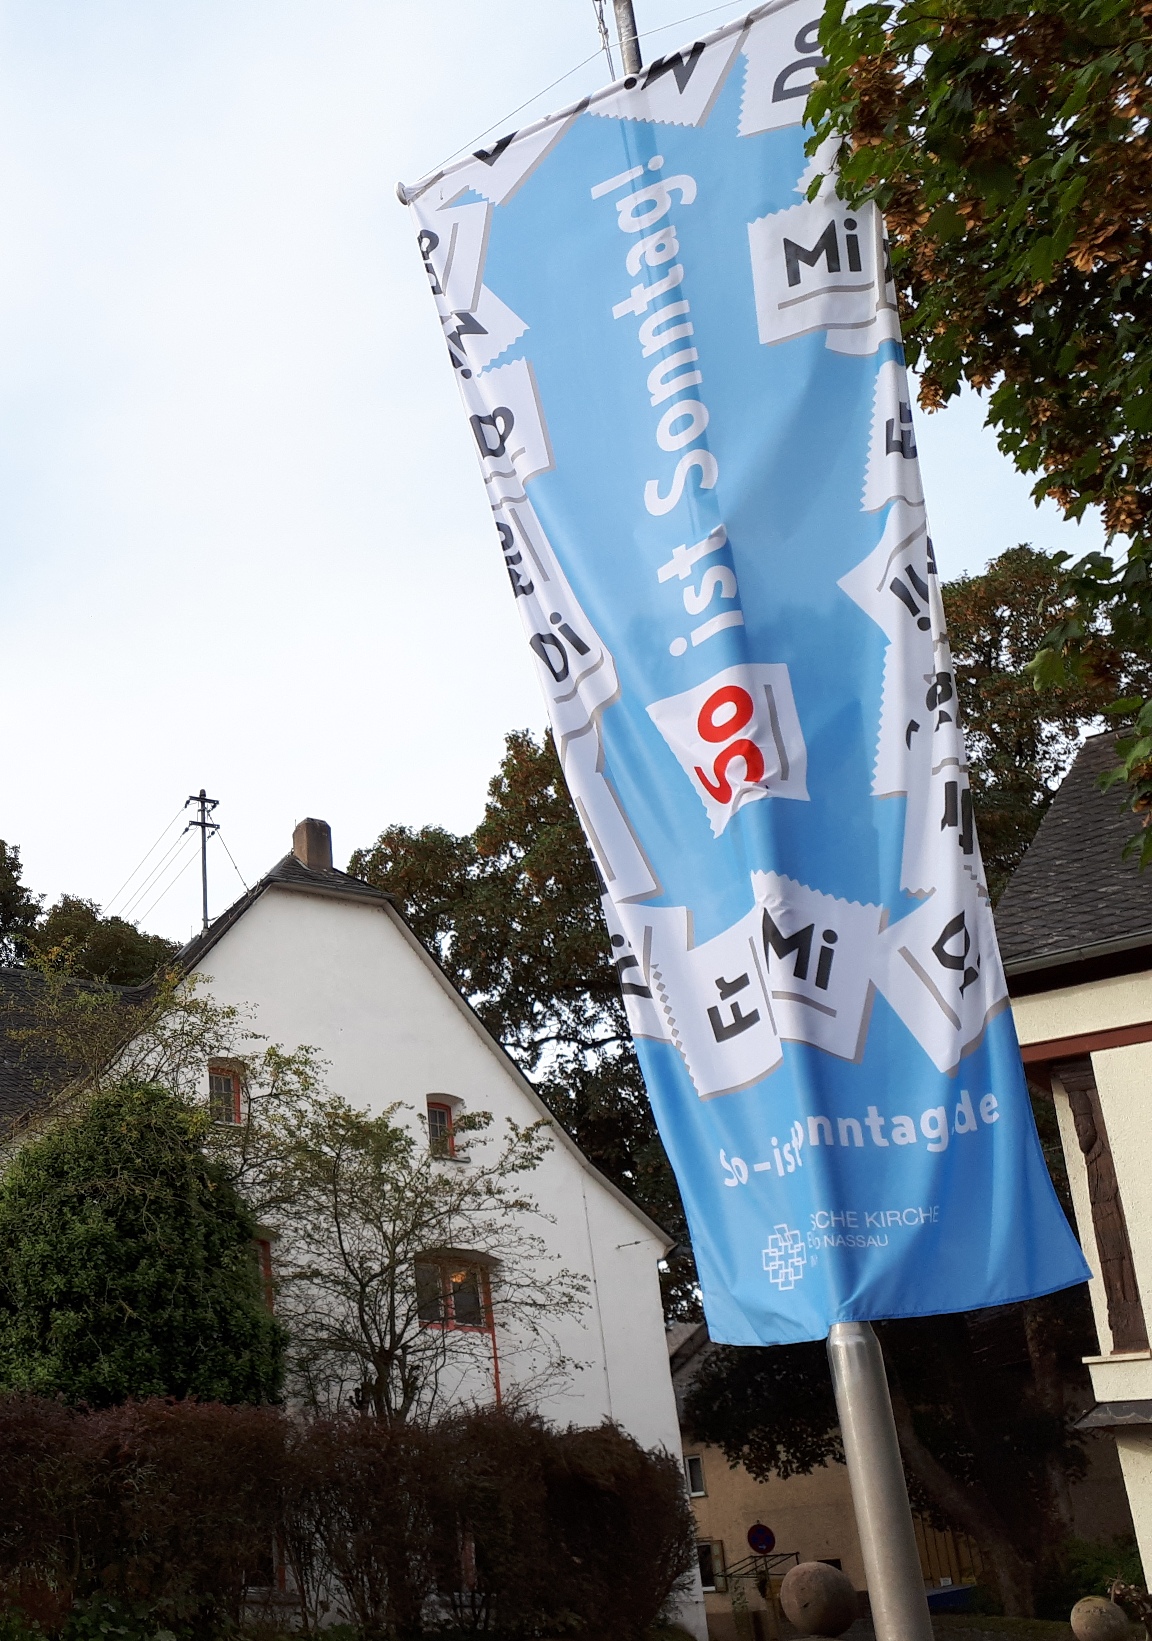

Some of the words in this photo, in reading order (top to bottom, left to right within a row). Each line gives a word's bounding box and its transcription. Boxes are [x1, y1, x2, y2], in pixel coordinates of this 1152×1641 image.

[783, 217, 862, 288] Mi
[590, 154, 719, 516] Sonntag!
[656, 523, 745, 657] ist
[529, 611, 591, 682] Di
[762, 906, 839, 991] Mi
[706, 972, 761, 1043] Fr
[824, 1233, 889, 1248] NASSAU
[864, 1205, 940, 1229] KIRCHE
